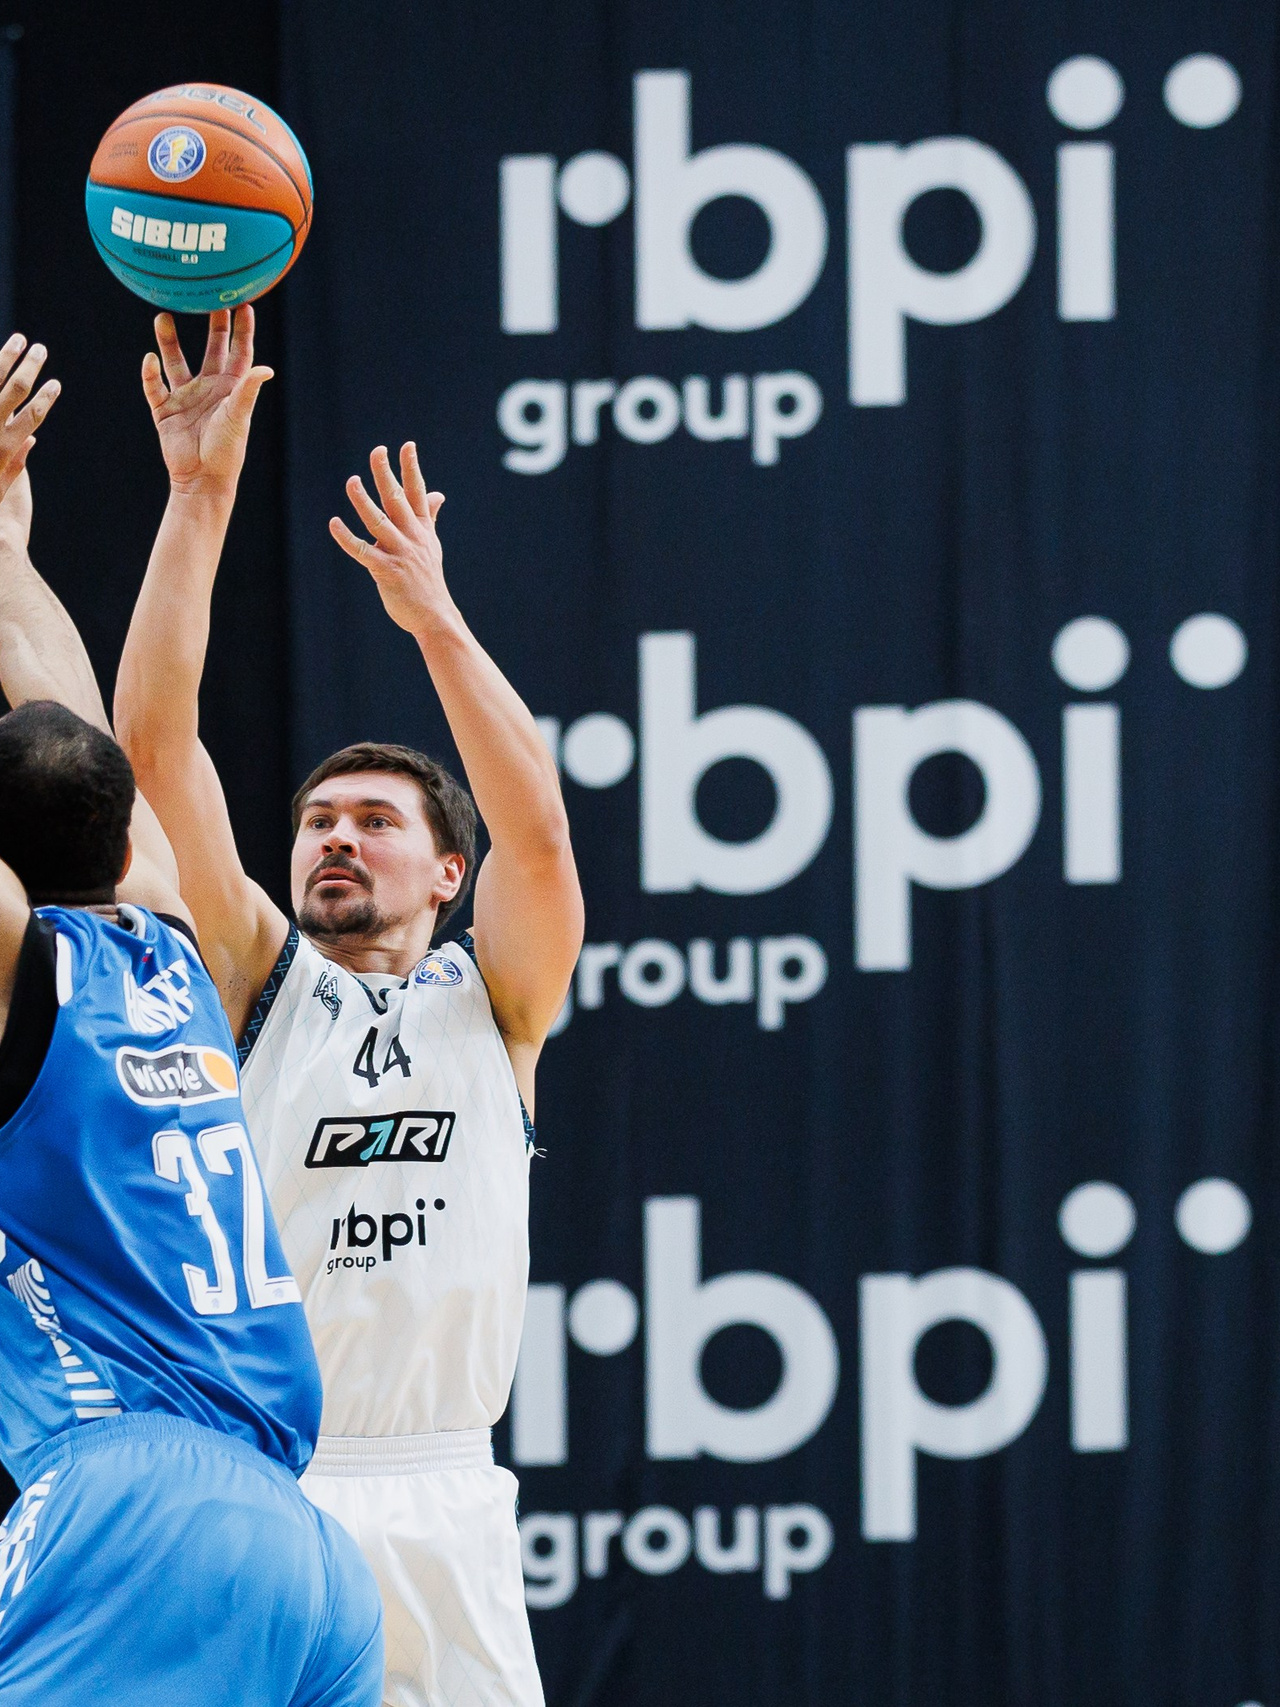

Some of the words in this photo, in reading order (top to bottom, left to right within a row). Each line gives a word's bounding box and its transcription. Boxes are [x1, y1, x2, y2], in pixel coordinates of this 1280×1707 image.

[111, 206, 227, 252] SIBUR
[499, 53, 1242, 407] rbpi
[498, 371, 823, 475] group
[547, 934, 829, 1038] roup
[353, 1026, 412, 1089] 44
[312, 1117, 451, 1162] PARI
[152, 1121, 303, 1315] 32
[326, 1255, 377, 1275] group
[520, 1501, 834, 1609] group
